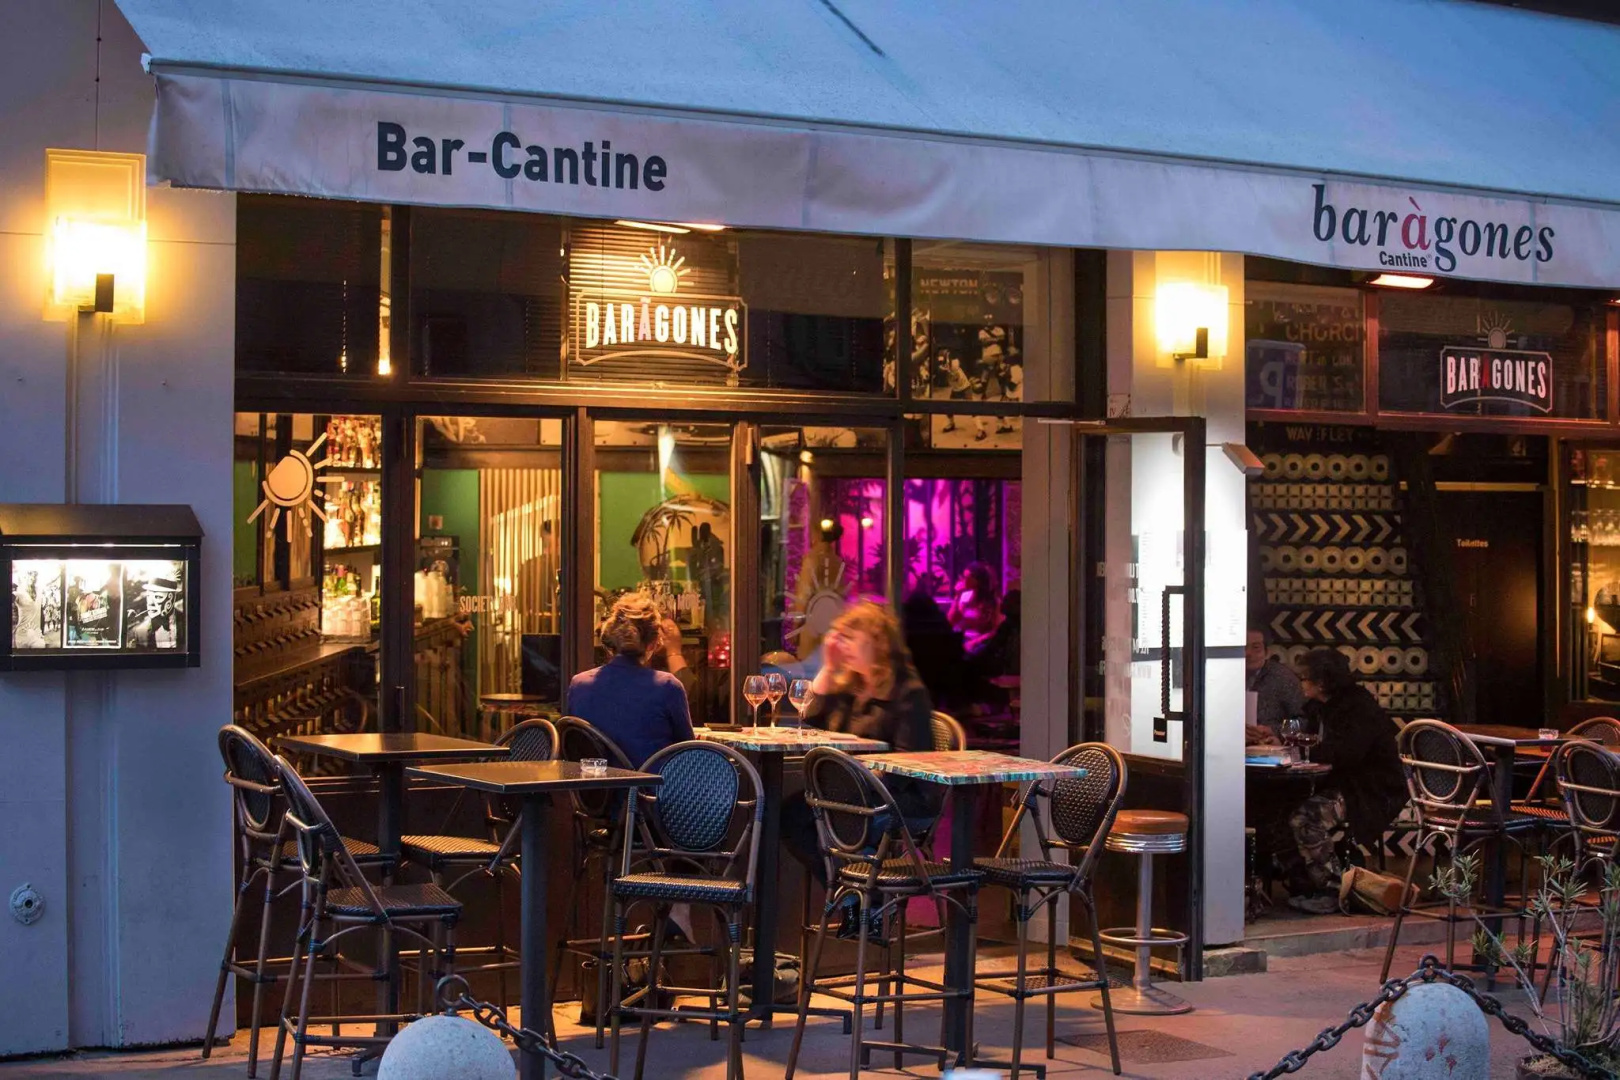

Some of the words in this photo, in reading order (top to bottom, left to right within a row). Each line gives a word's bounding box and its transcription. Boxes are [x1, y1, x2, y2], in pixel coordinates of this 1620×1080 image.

[377, 121, 668, 192] Bar-Cantine
[1312, 184, 1555, 272] baràgones
[1285, 426, 1355, 443] WAVLEY
[1456, 538, 1489, 548] Toilettes
